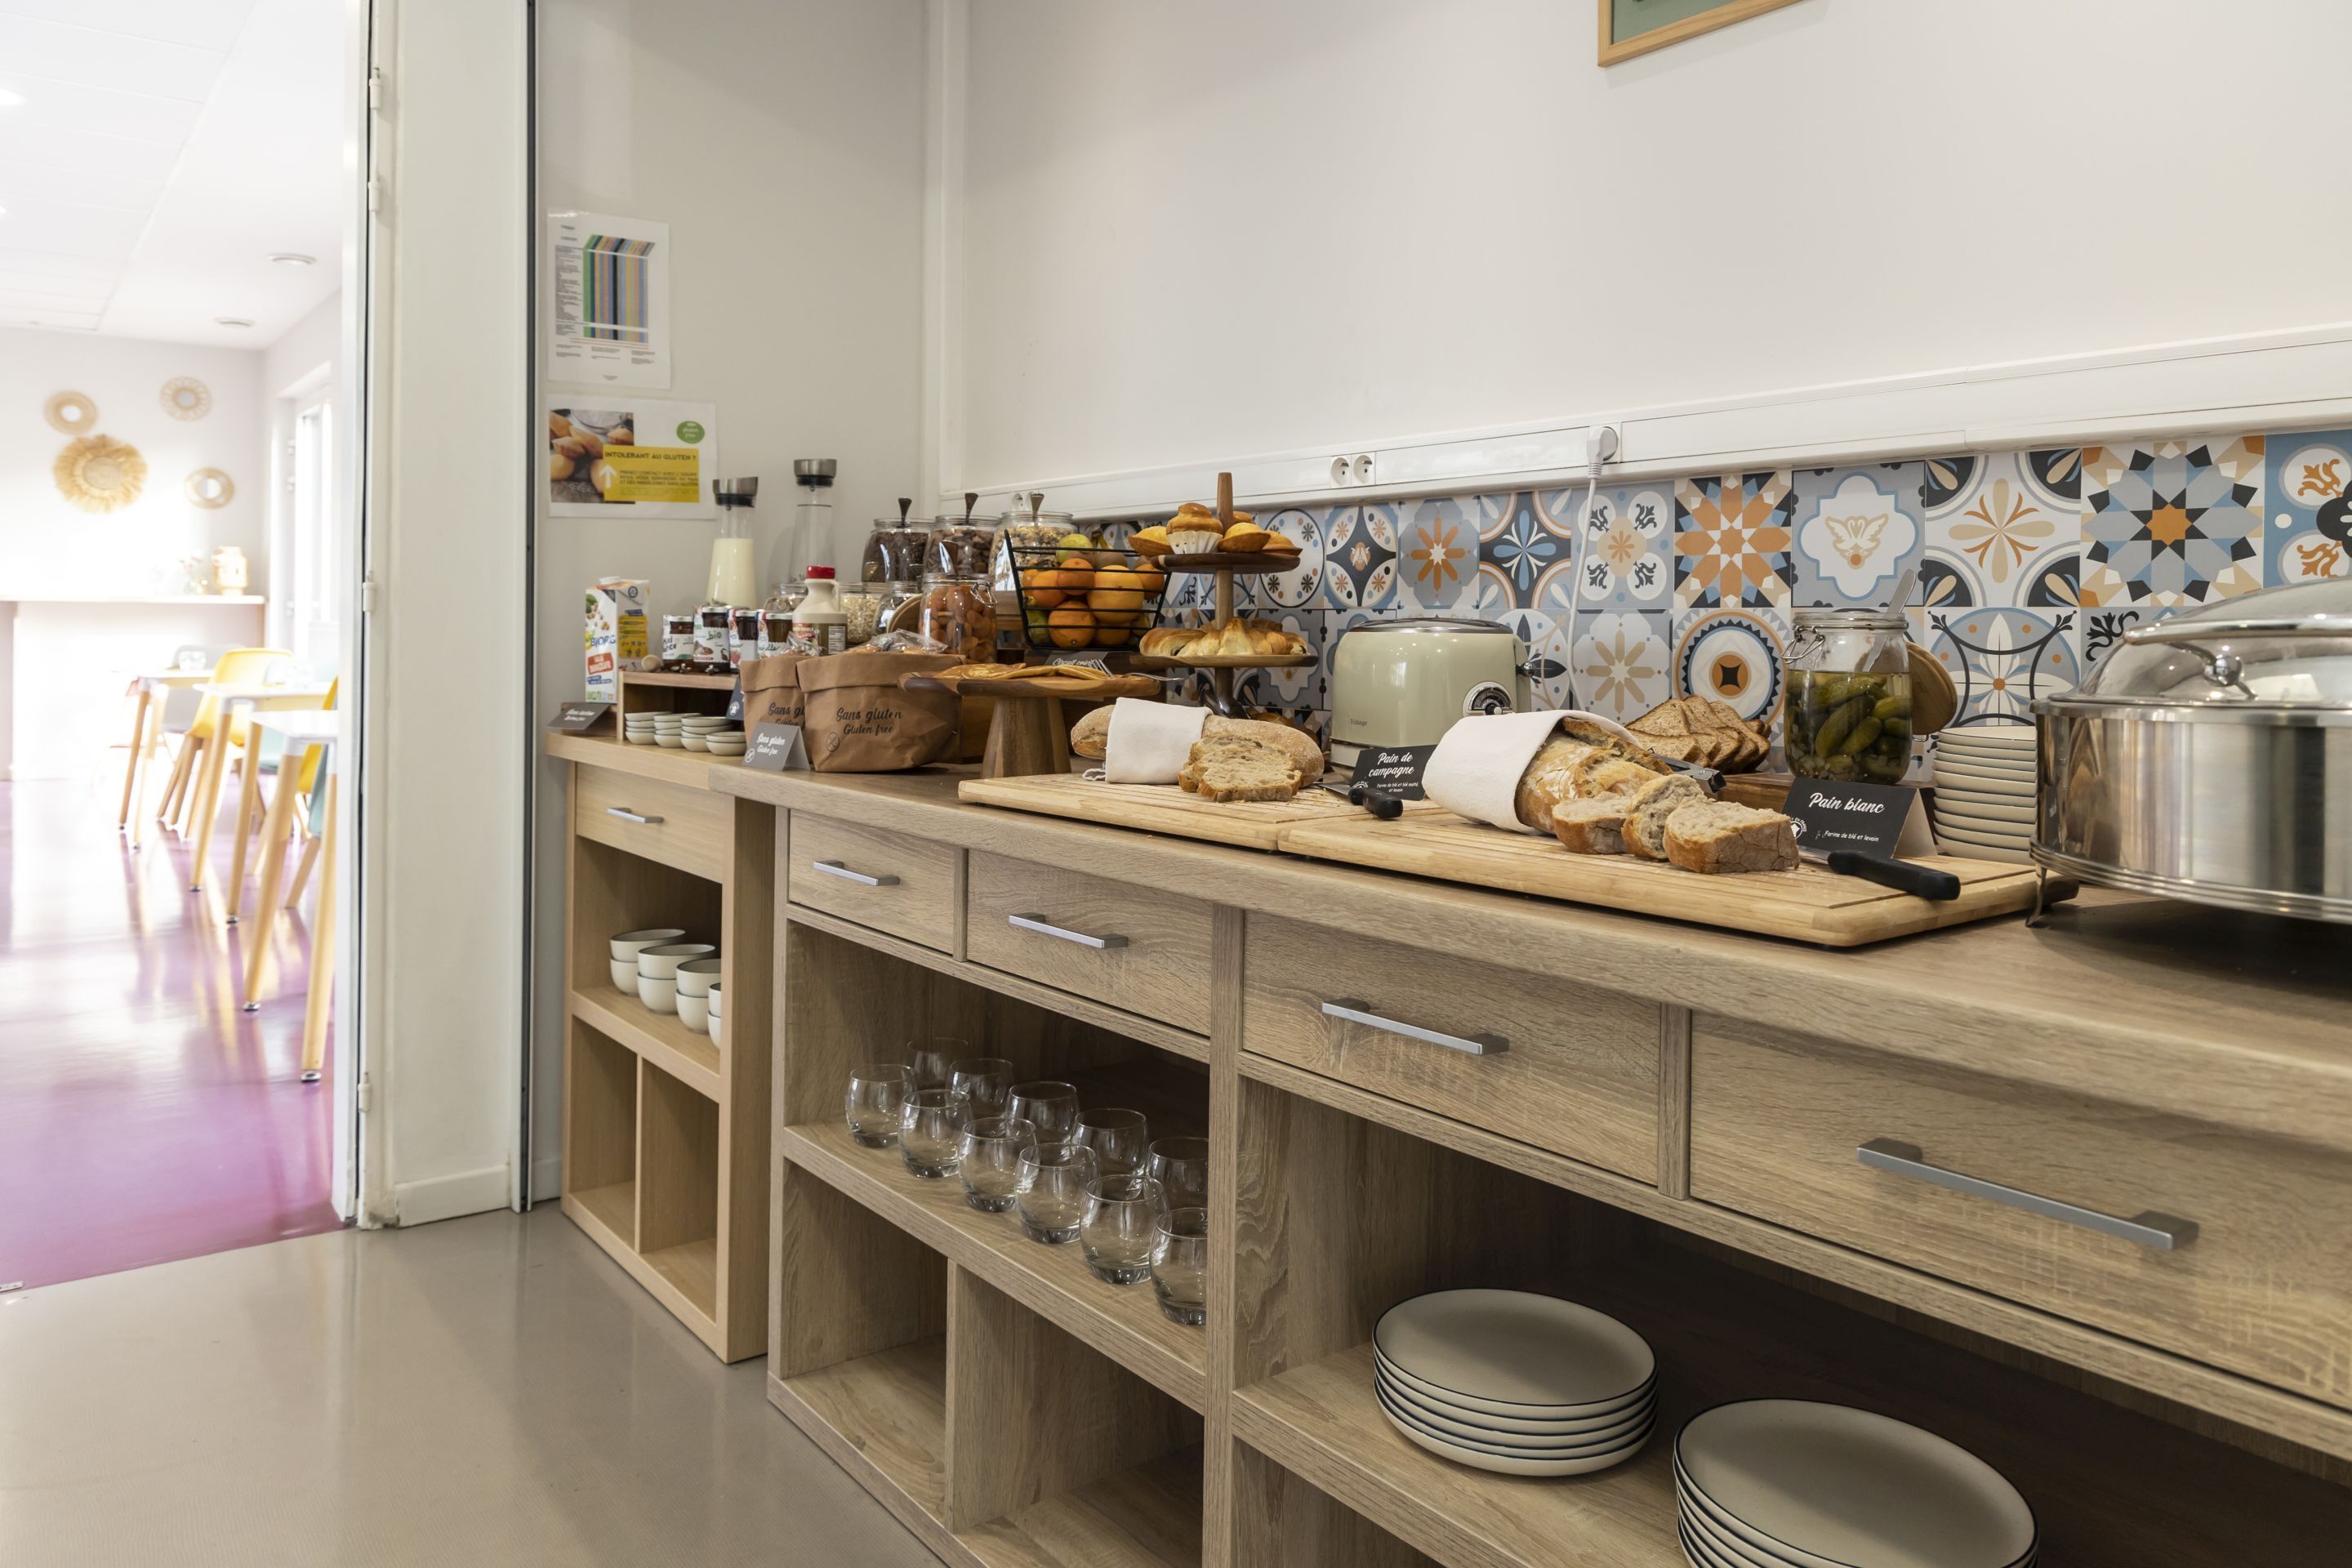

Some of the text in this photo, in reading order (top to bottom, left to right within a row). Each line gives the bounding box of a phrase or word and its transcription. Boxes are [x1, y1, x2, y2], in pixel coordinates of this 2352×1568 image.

[768, 702, 791, 716] Sans
[836, 707, 902, 724] Sans gluten
[843, 724, 893, 737] Gluten free
[1377, 751, 1414, 765] Pain de
[1368, 766, 1415, 778] campagne
[1808, 792, 1885, 813] Pain blanc
